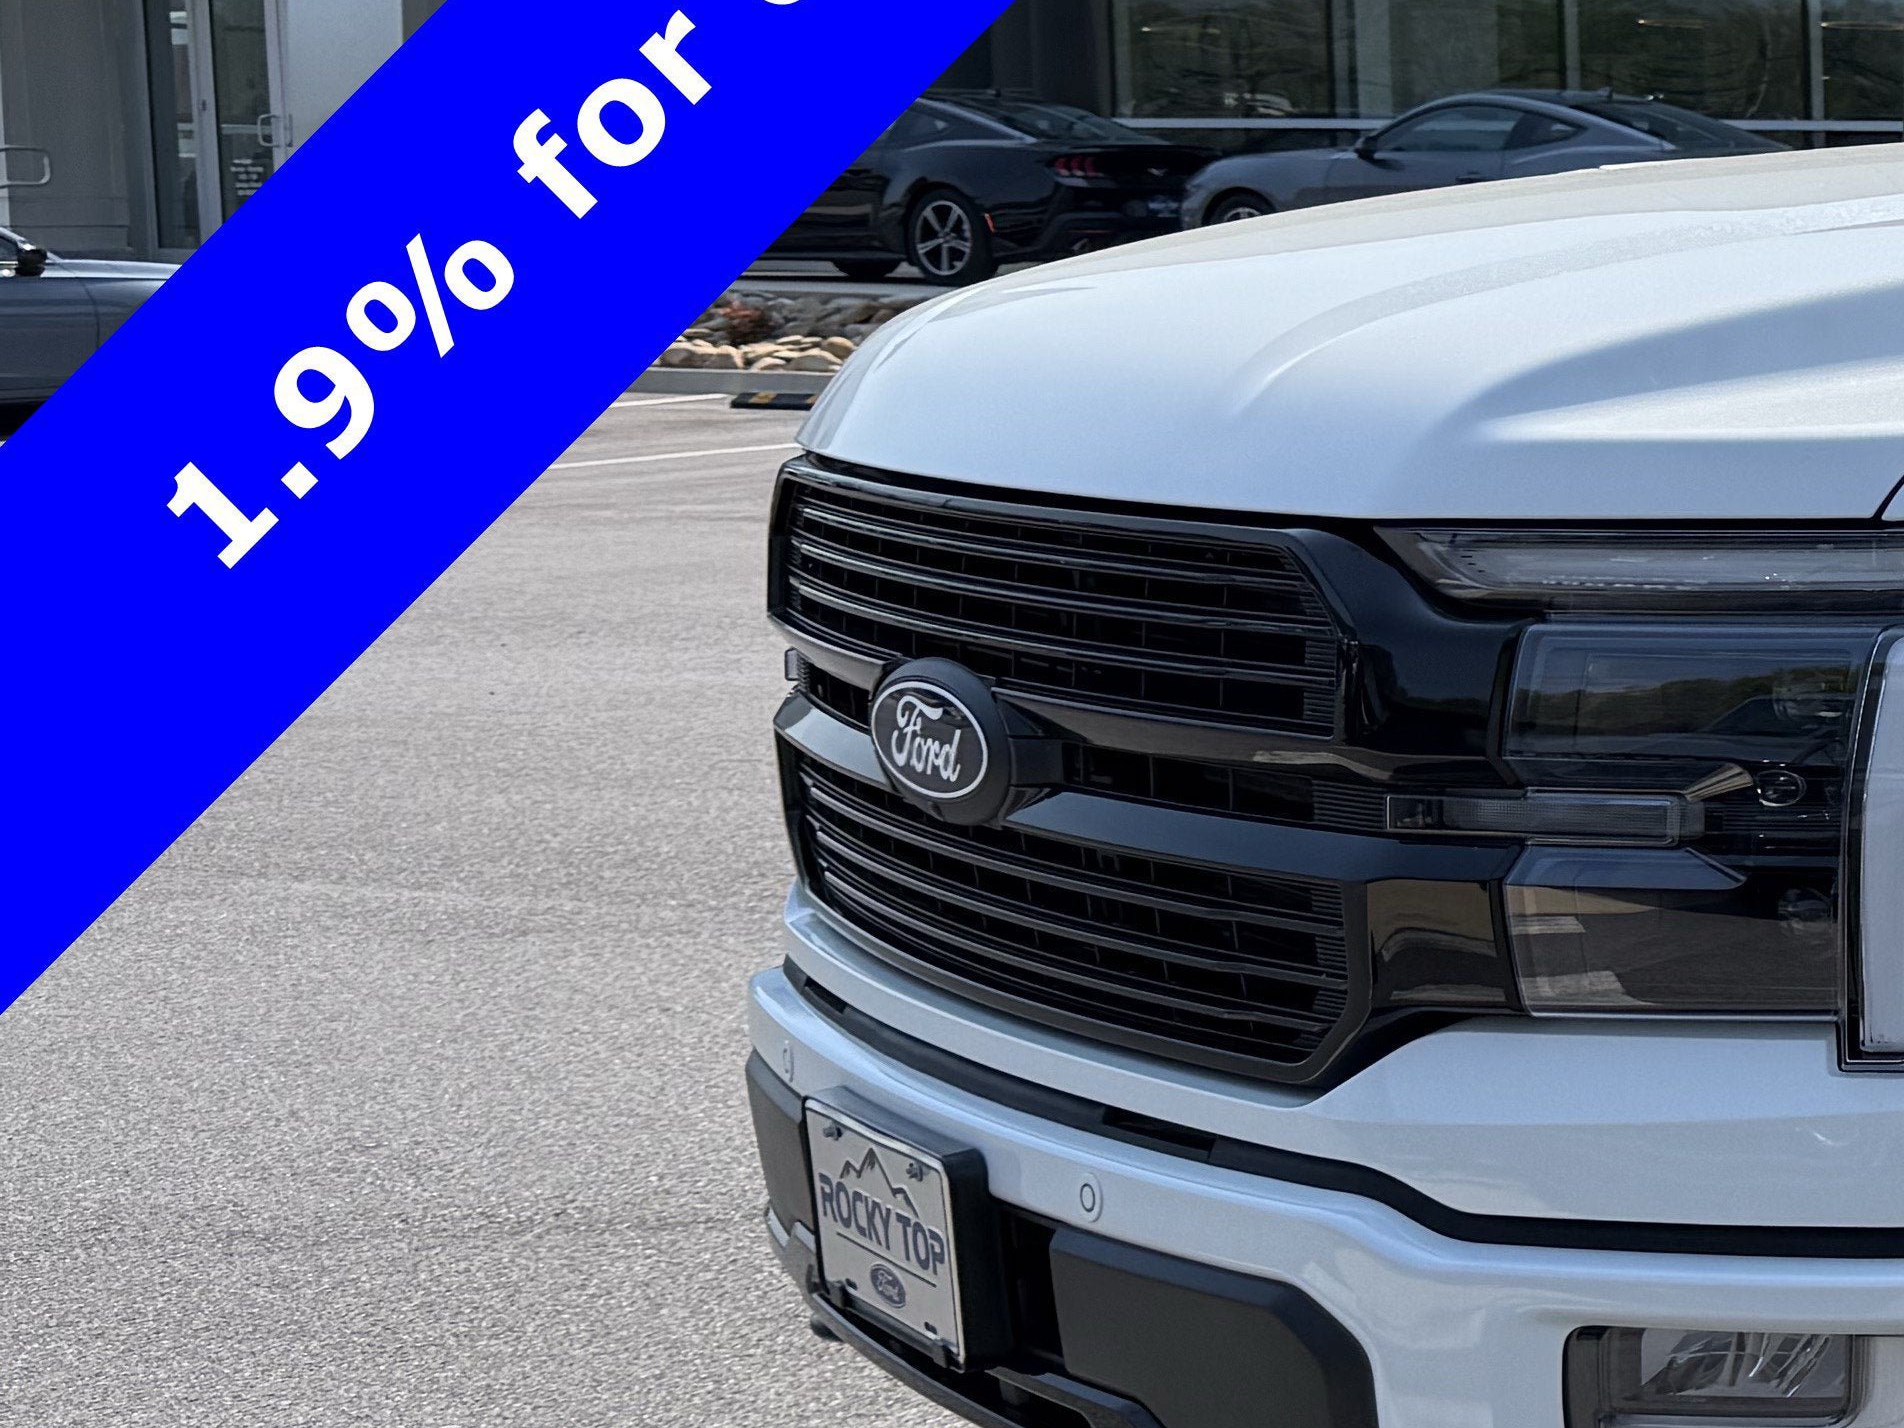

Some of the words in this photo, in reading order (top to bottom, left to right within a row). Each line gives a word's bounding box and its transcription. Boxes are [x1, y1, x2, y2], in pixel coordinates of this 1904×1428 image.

[891, 695, 961, 782] Ford
[818, 1172, 892, 1251] ROCKY
[895, 1212, 945, 1275] TOP
